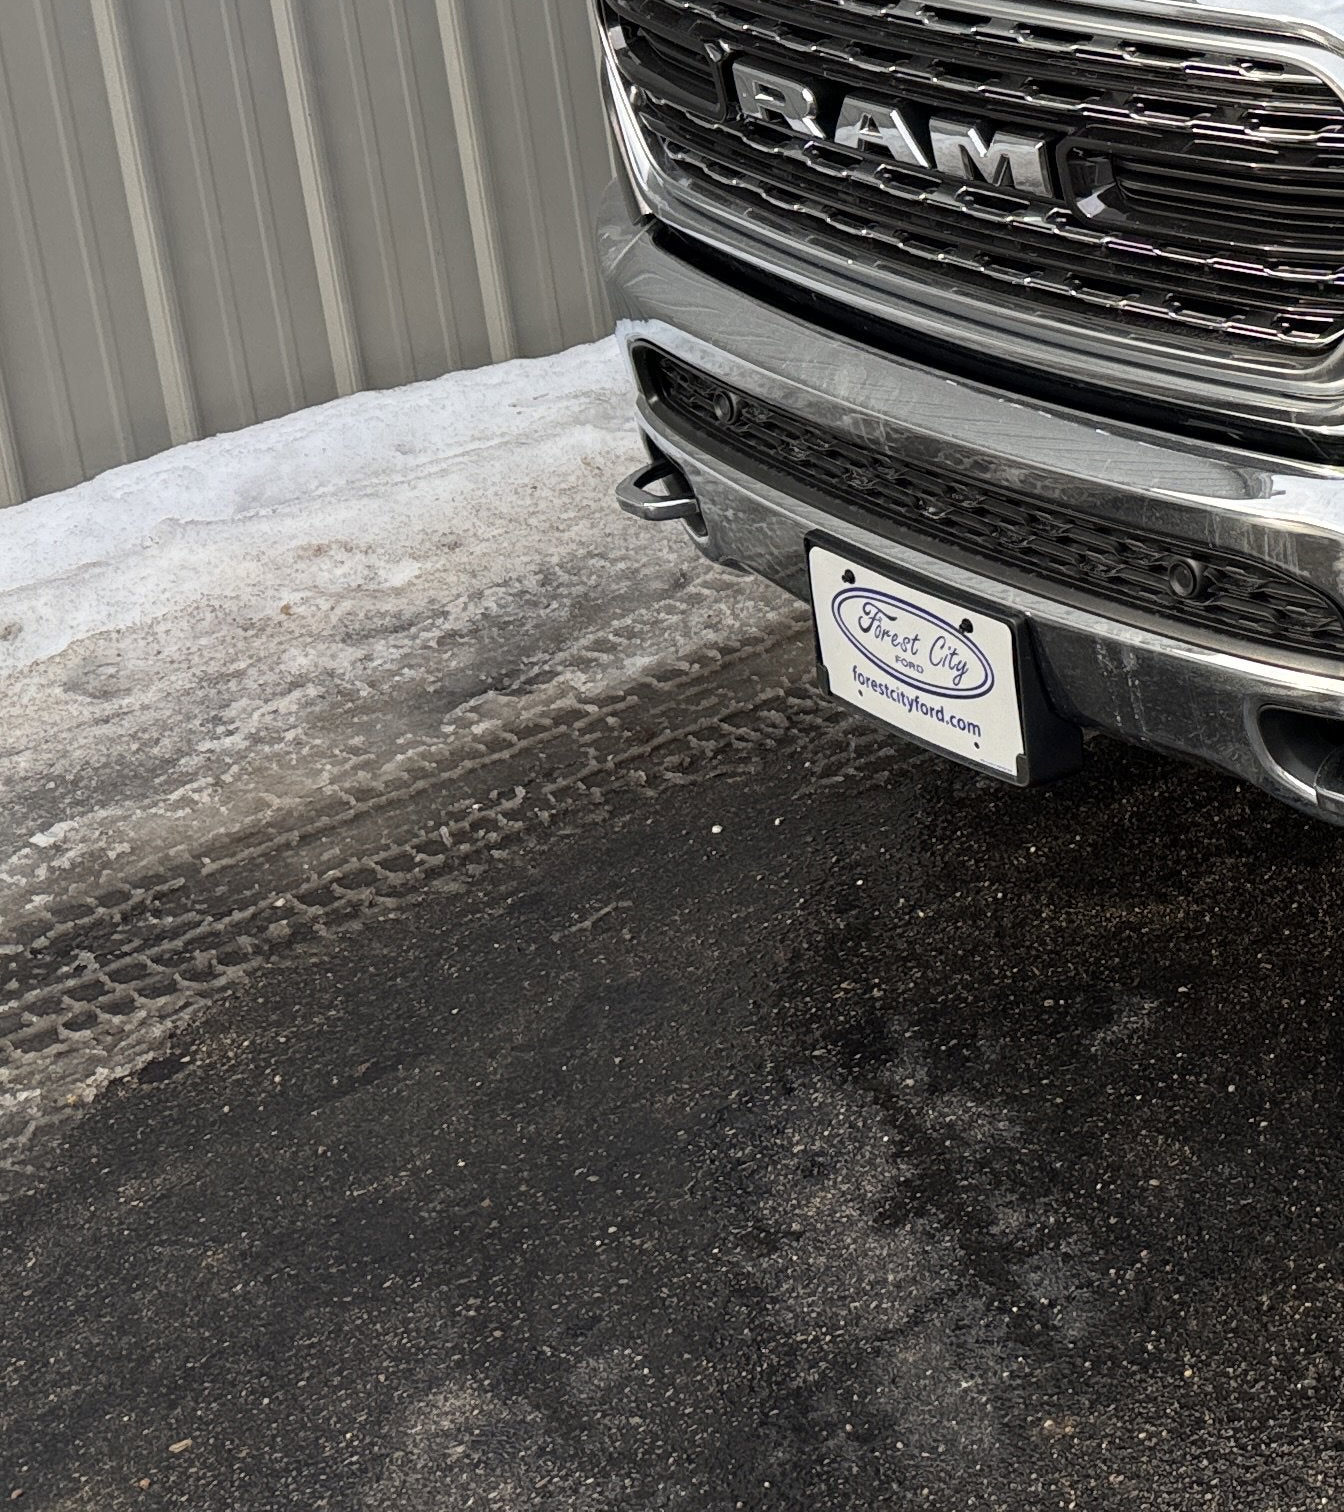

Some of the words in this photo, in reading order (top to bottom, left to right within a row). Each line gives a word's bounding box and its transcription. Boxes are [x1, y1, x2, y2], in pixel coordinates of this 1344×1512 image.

[731, 56, 1056, 199] RAM
[858, 601, 921, 656] Forest
[929, 635, 969, 686] City
[895, 654, 924, 674] FORD
[852, 664, 982, 738] forestcityford.com
